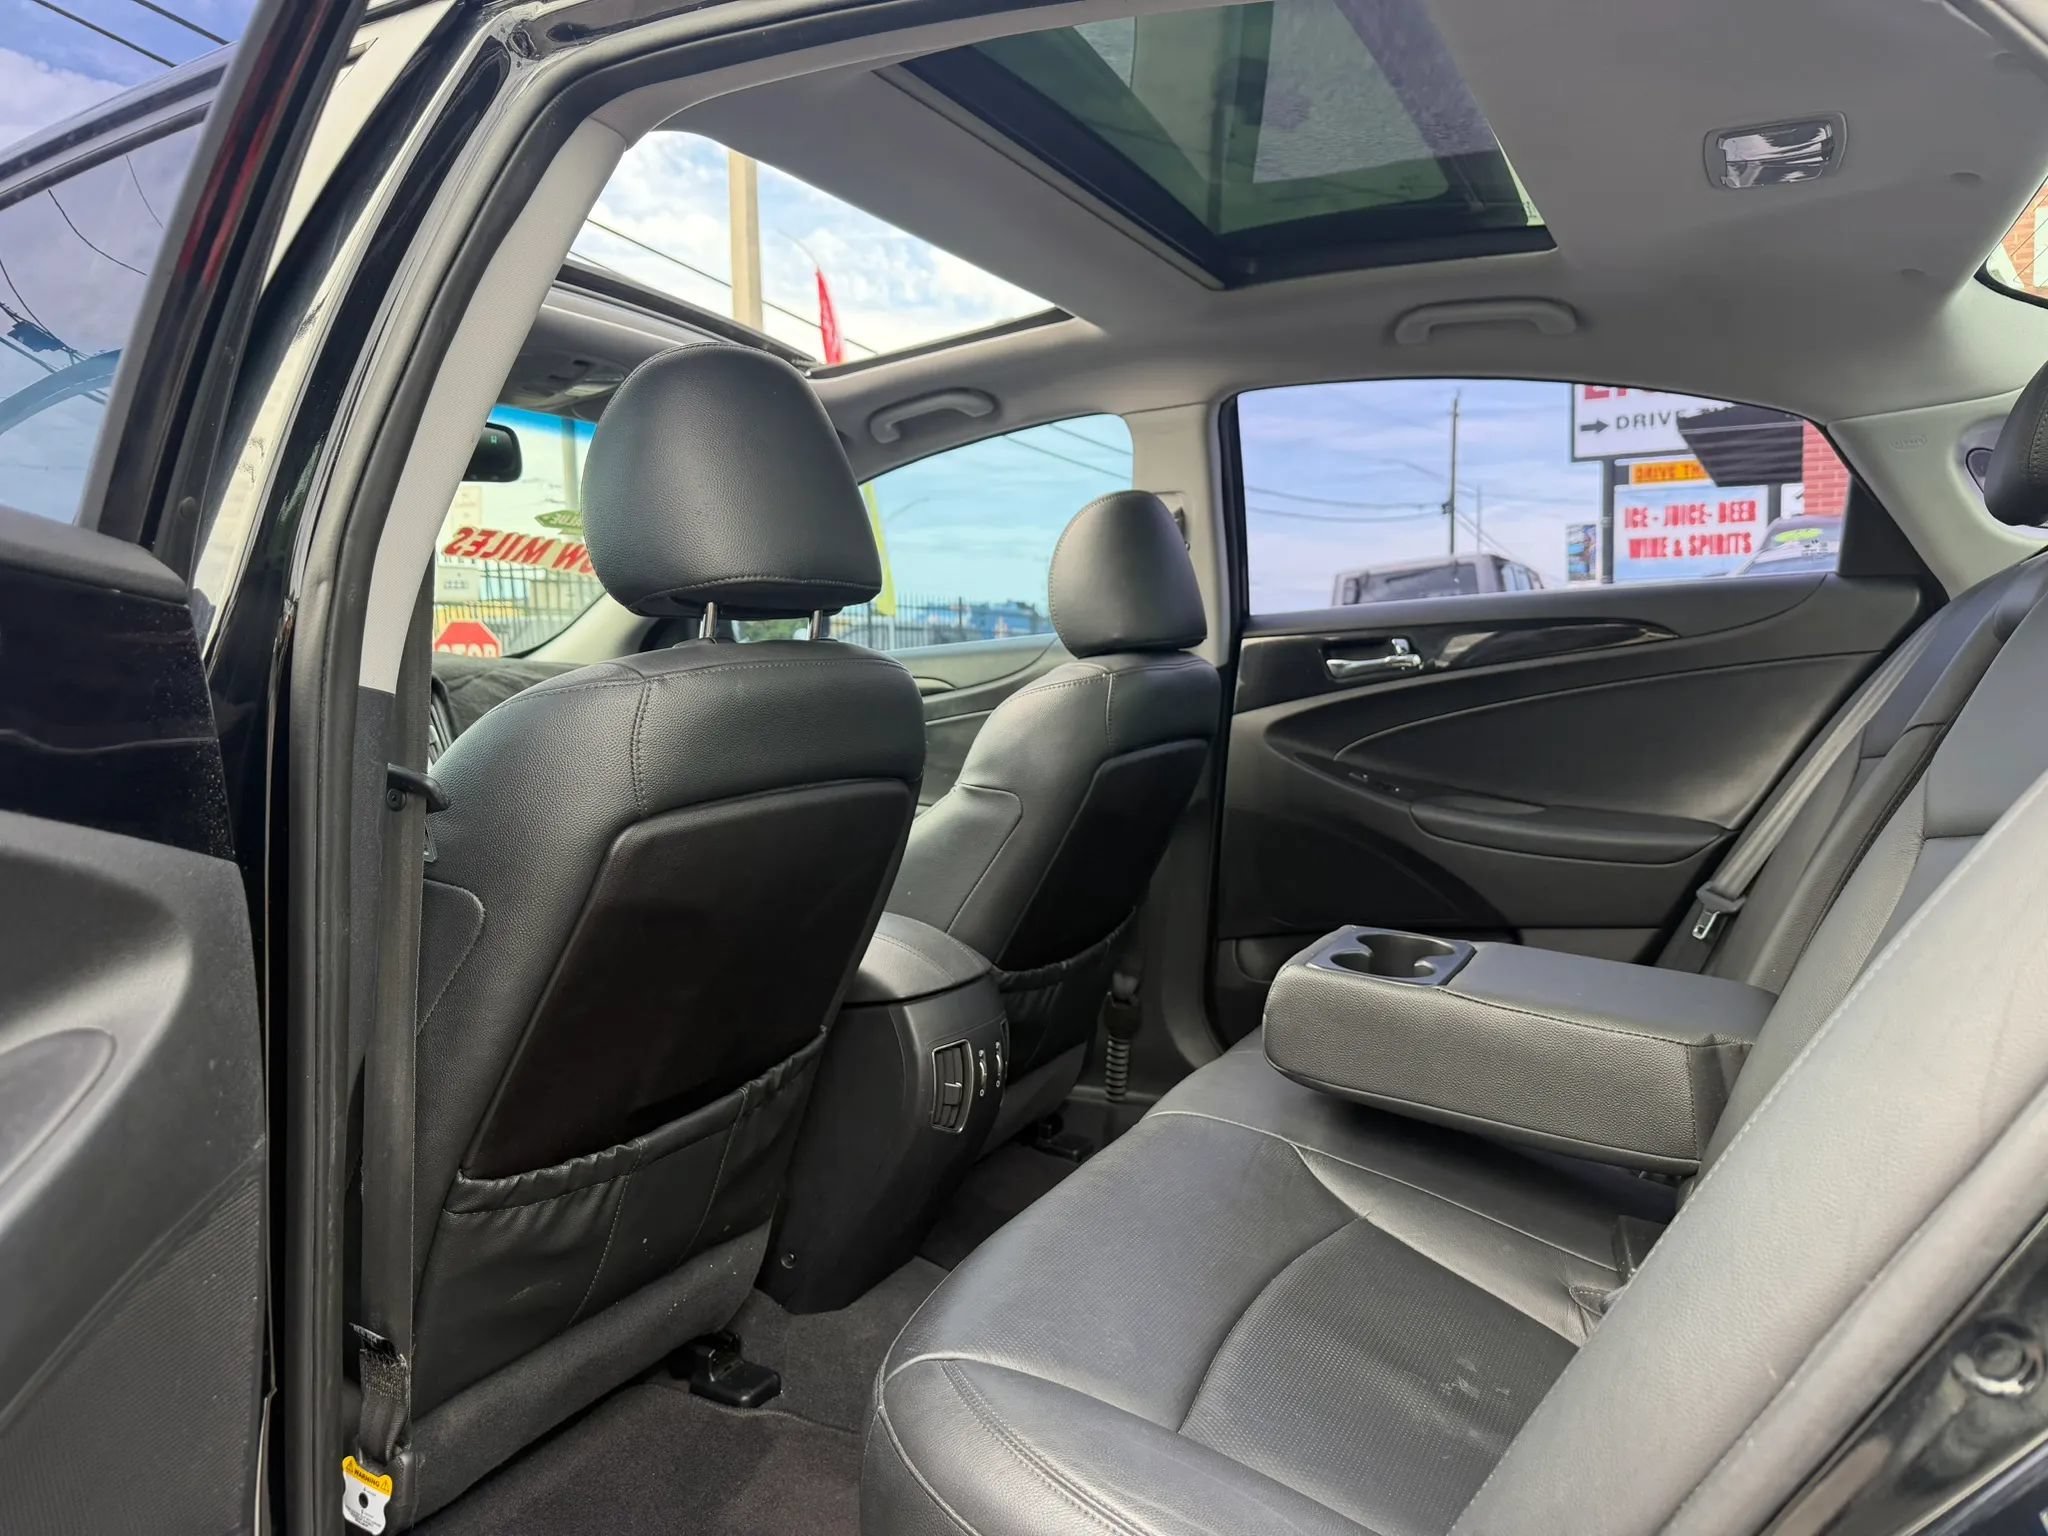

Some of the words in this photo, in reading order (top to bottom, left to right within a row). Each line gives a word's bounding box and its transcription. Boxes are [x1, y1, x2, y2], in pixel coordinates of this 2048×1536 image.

[1624, 507, 1648, 528] ICE
[1689, 532, 1752, 555] SPIRITS
[354, 1470, 380, 1488] WARNING
